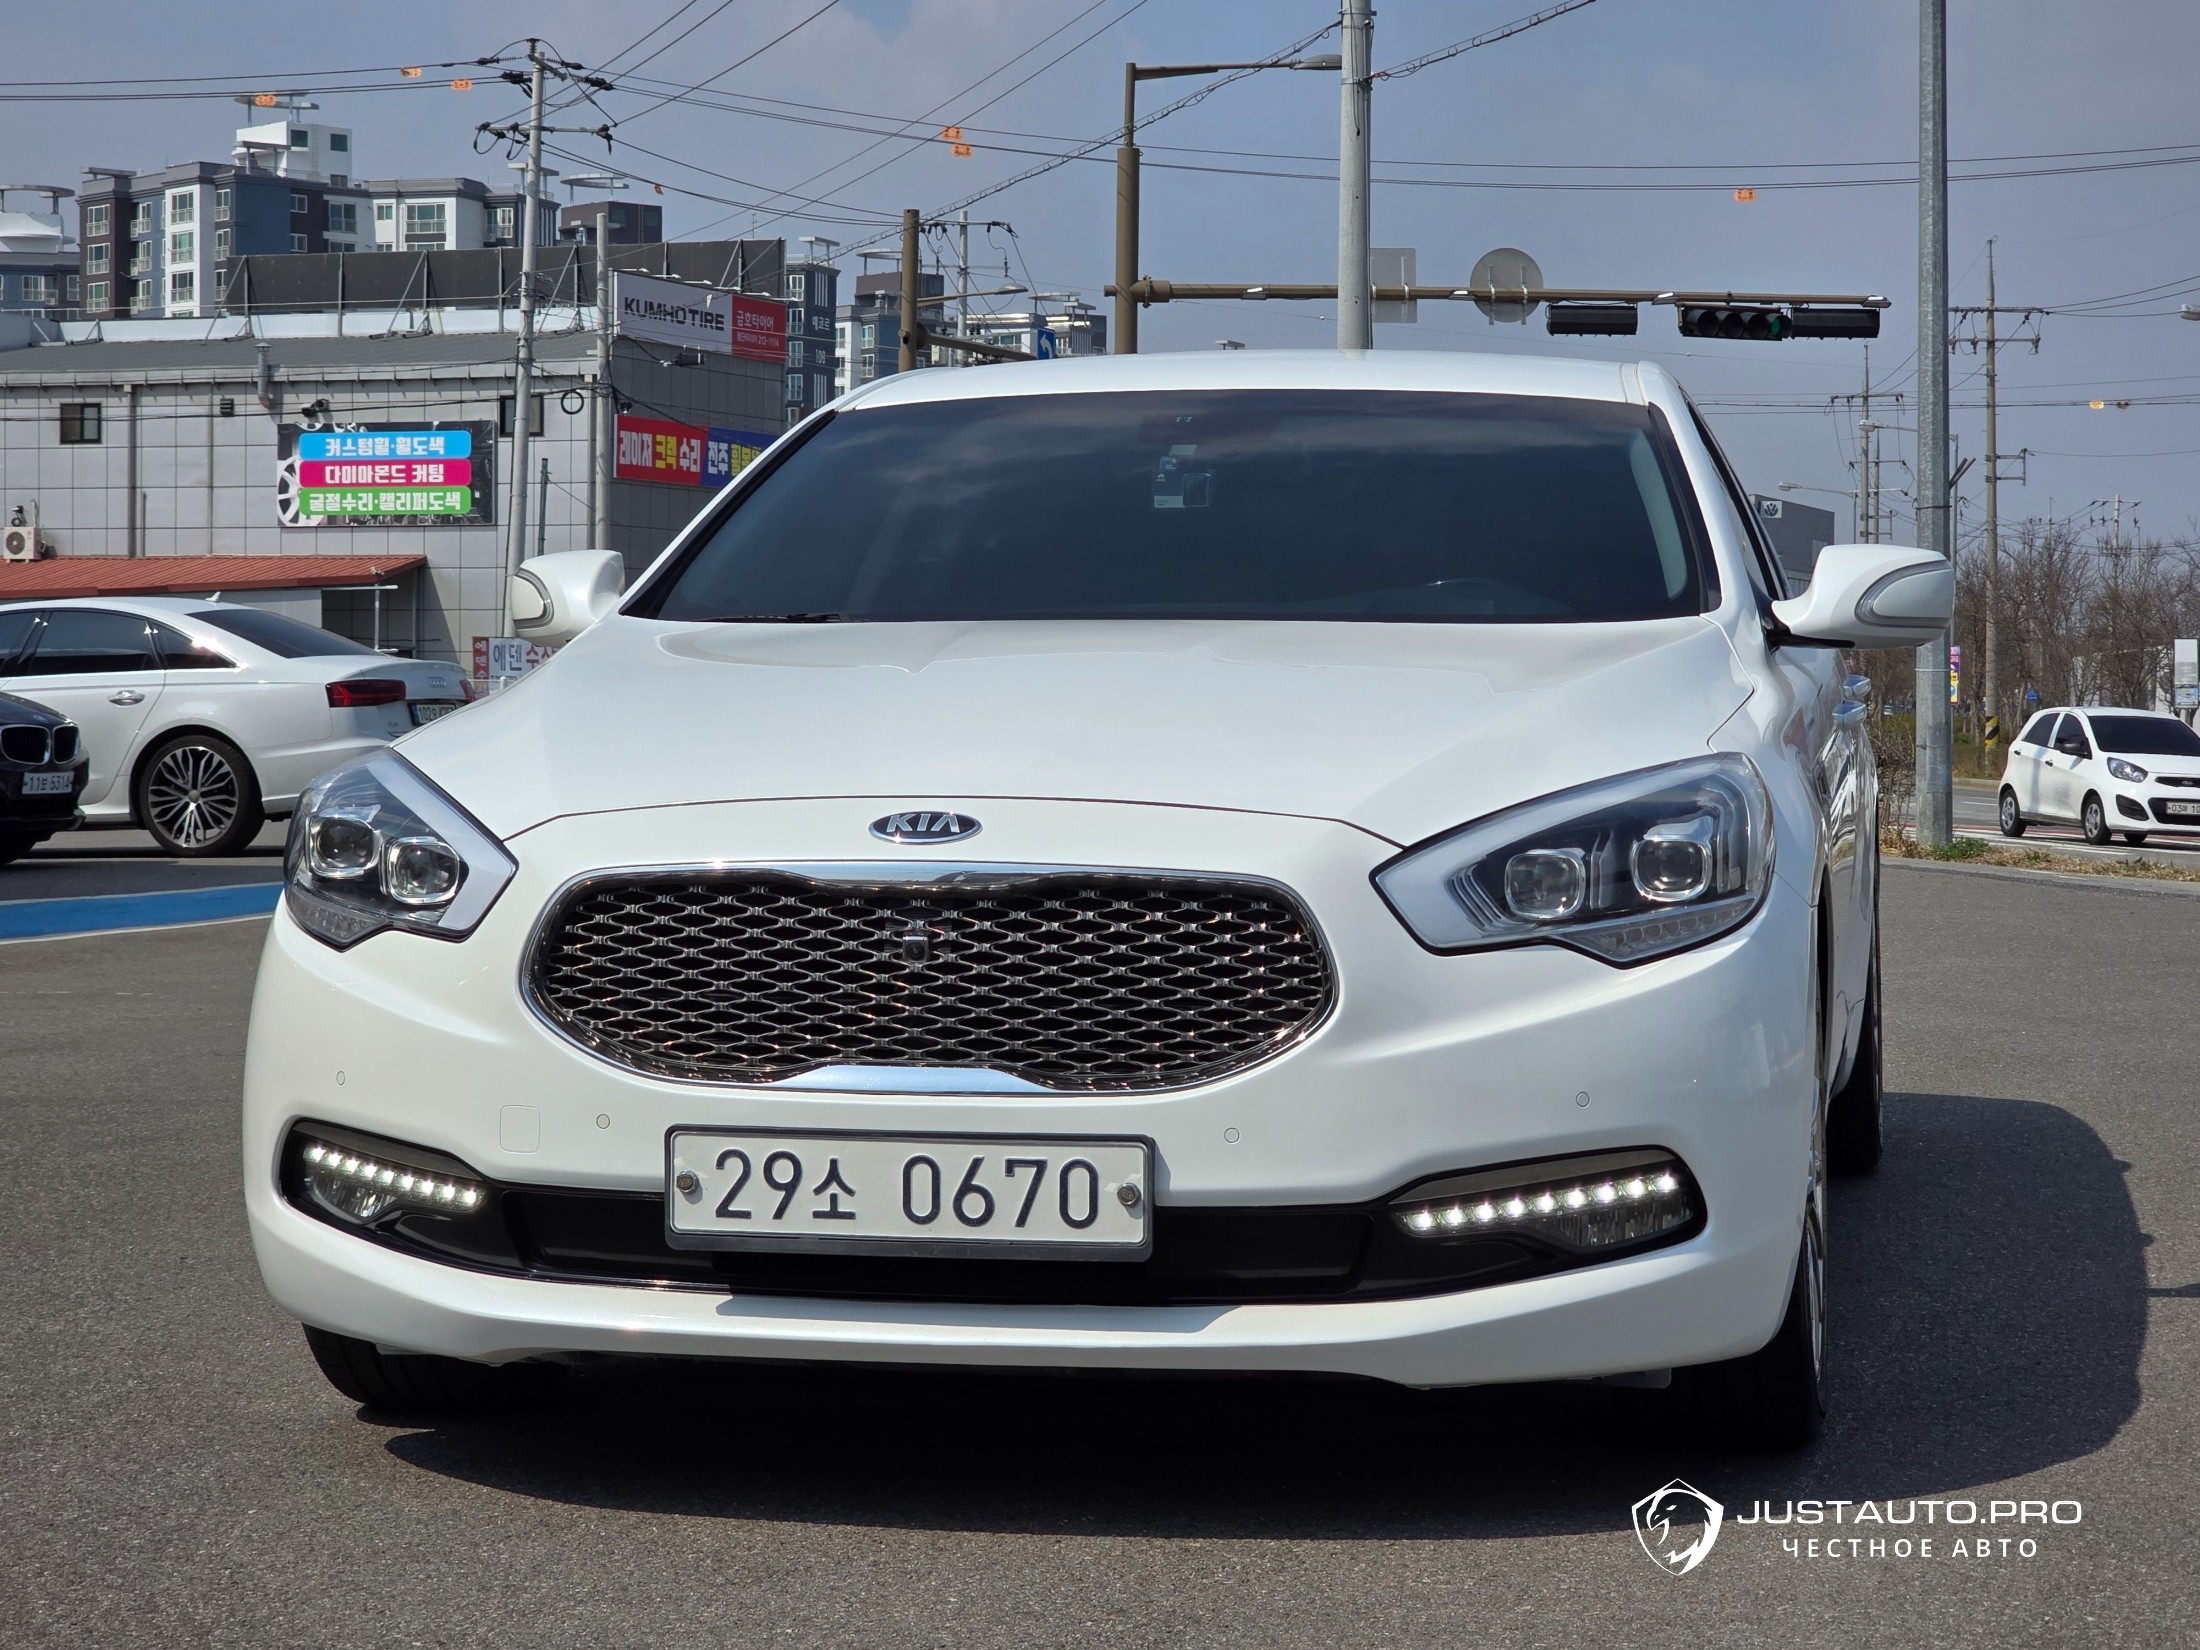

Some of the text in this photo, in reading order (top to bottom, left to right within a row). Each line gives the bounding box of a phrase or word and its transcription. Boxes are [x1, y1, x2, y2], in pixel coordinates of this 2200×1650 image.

[624, 297, 725, 331] KUMHO TIRE
[736, 310, 774, 332] 금호타이어
[679, 437, 701, 473] 수리
[707, 441, 729, 475] 전주
[325, 464, 444, 484] 다이아몬드 커팅
[493, 644, 522, 671] 에덴
[886, 813, 960, 833] KIA
[714, 1148, 1099, 1229] 29소 0670
